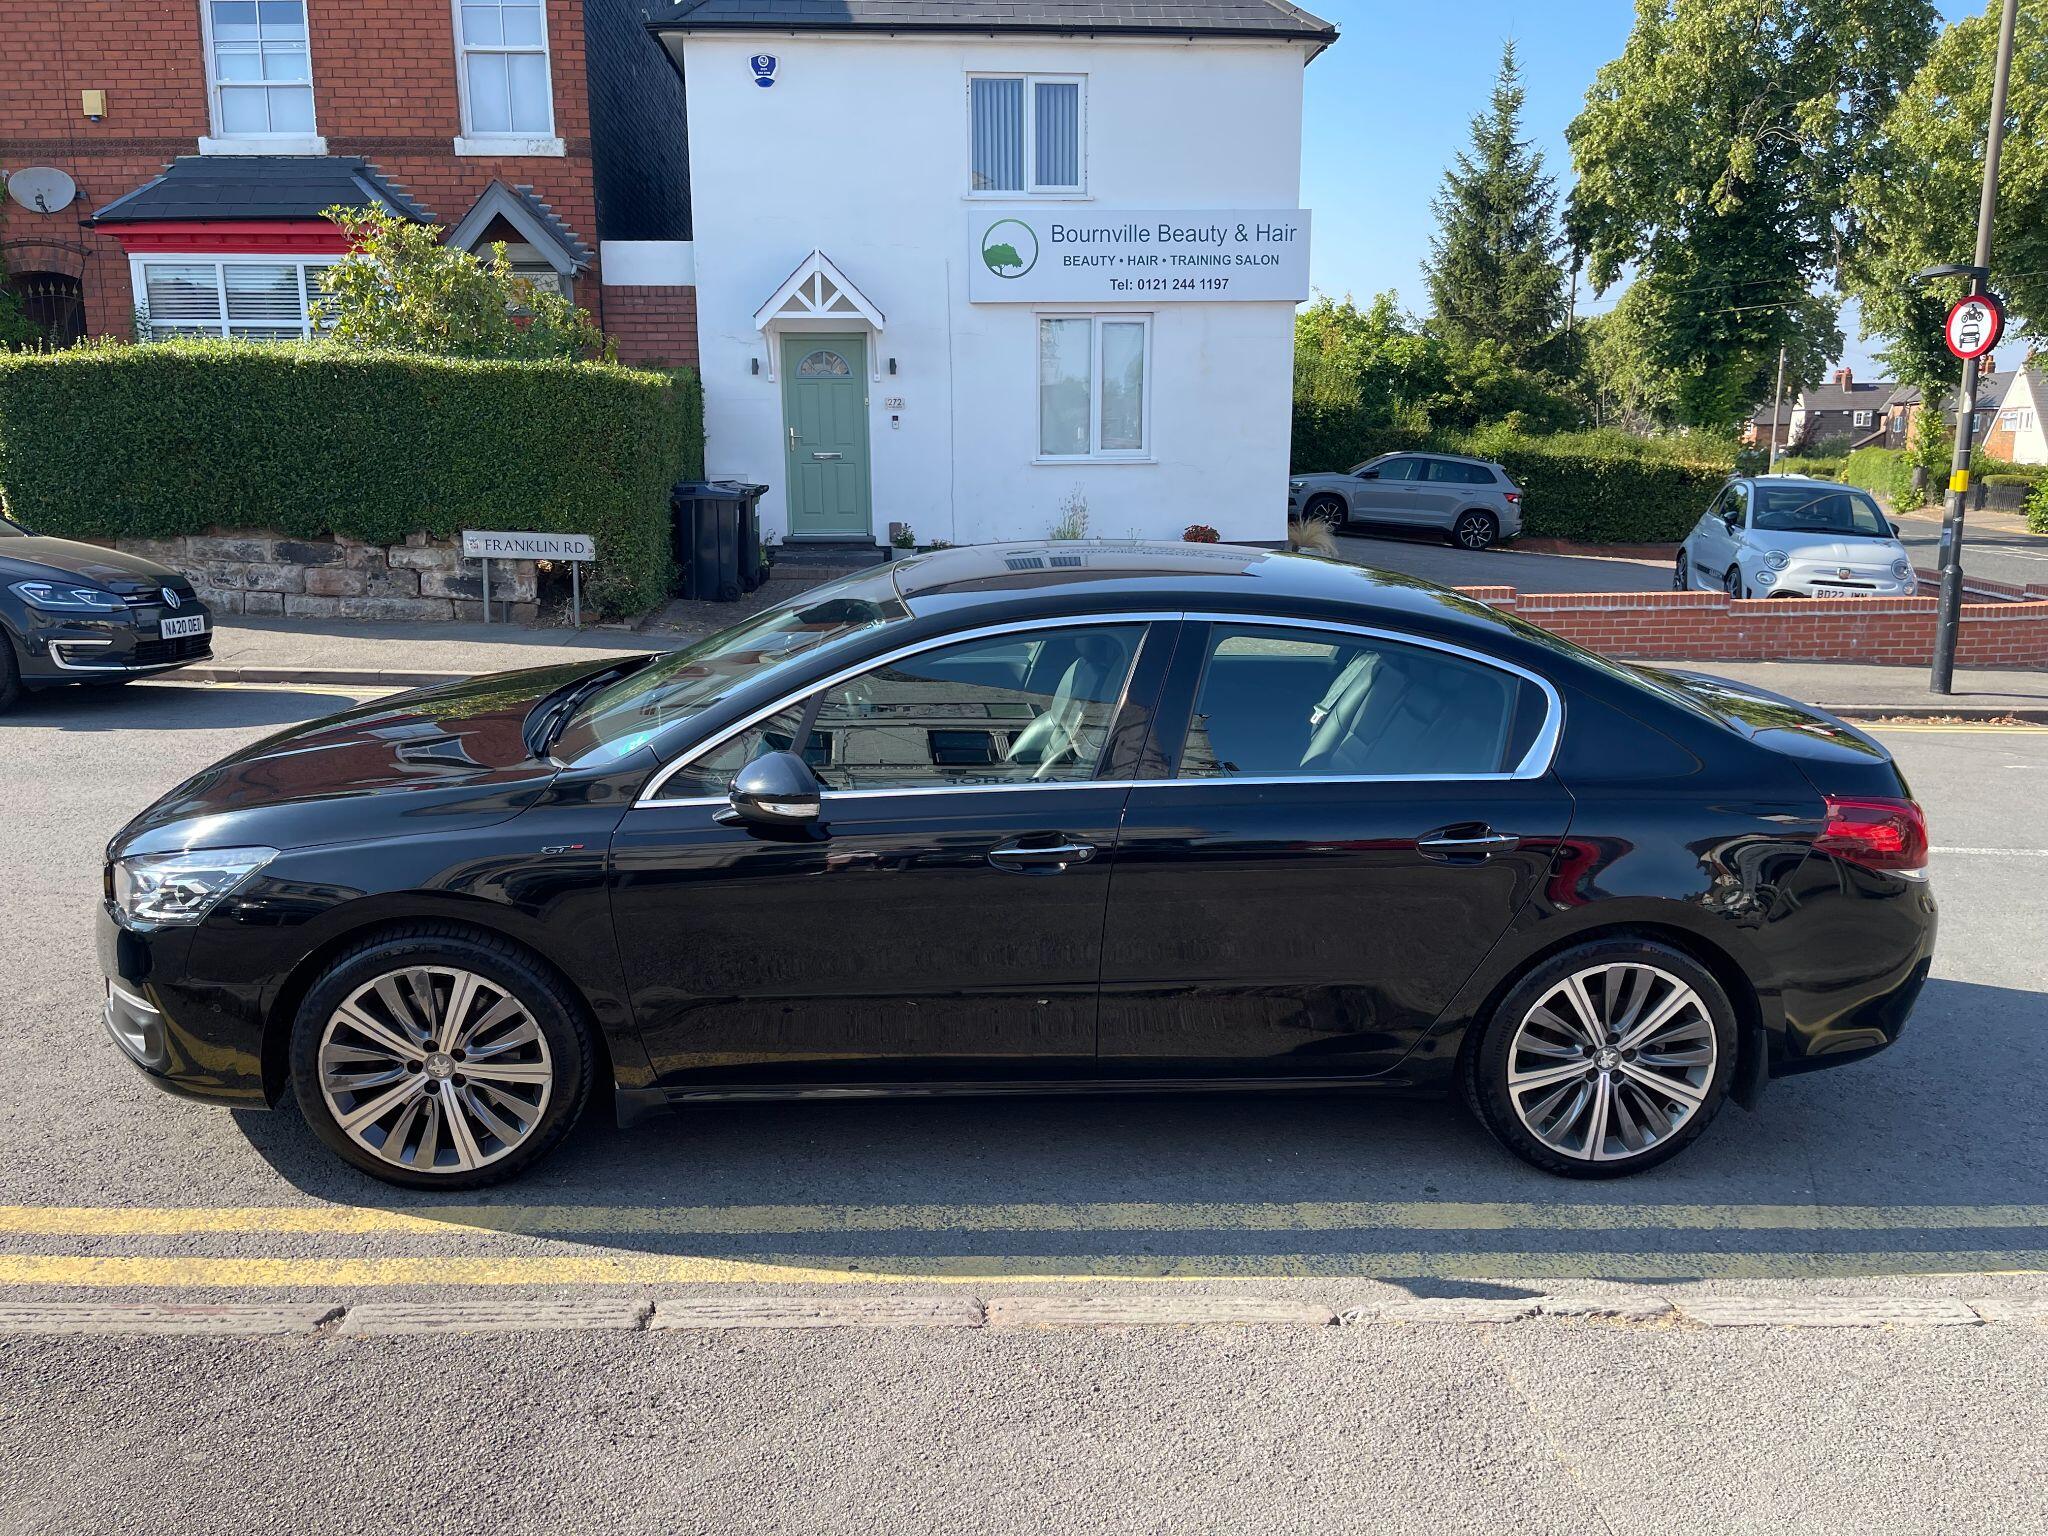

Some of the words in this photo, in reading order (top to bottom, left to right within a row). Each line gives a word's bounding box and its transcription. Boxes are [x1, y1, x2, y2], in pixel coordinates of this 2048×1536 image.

[1051, 224, 1151, 243] Bournville
[1157, 224, 1228, 247] Beauty
[1234, 224, 1249, 242] &
[1256, 223, 1298, 243] Hair
[1063, 255, 1116, 267] BEAUTY
[1127, 255, 1159, 267] HAIR
[1170, 254, 1232, 266] TRAINING
[1235, 254, 1280, 266] SALON
[1110, 278, 1133, 291] Tel:
[1137, 278, 1168, 291] 0121
[1172, 278, 1196, 291] 244
[1200, 278, 1230, 291] 1197
[485, 539, 559, 553] FRANKLIN
[165, 620, 187, 635] NA20
